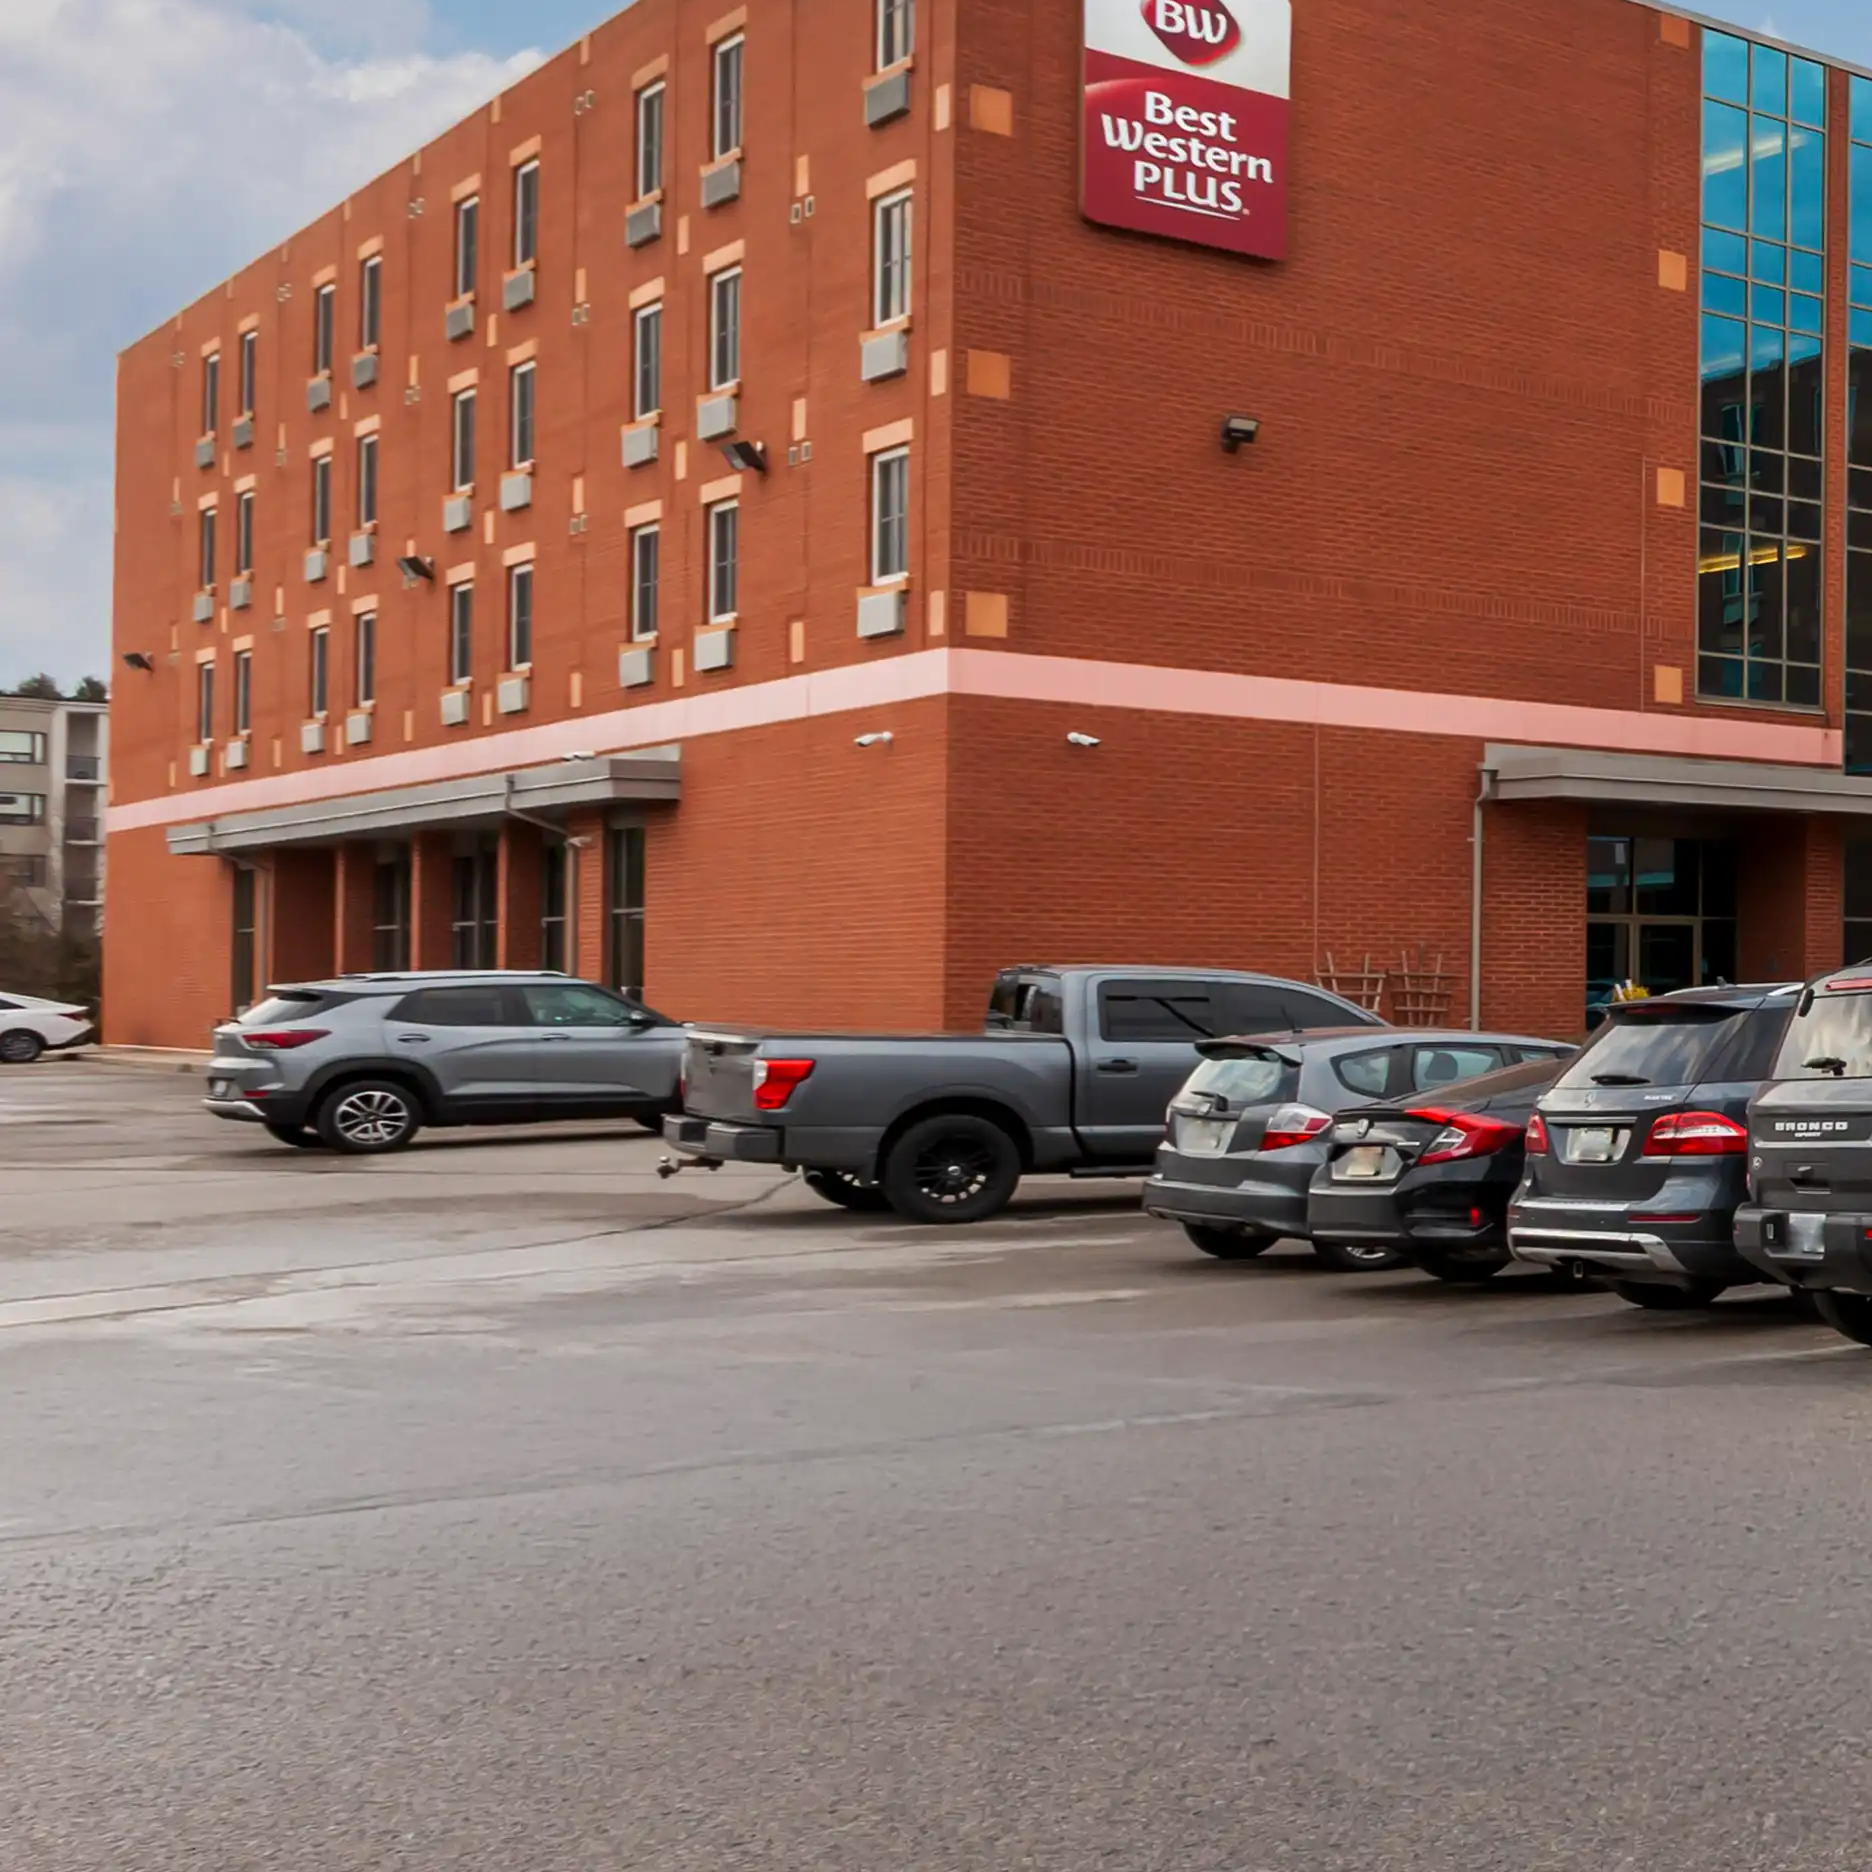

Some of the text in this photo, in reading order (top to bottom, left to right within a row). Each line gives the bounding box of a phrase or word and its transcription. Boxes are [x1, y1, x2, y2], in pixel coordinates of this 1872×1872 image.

[1144, 90, 1237, 142] Best
[1101, 113, 1274, 184] Western
[1134, 161, 1243, 213] PLUS
[1774, 1121, 1848, 1131] BRONCO
